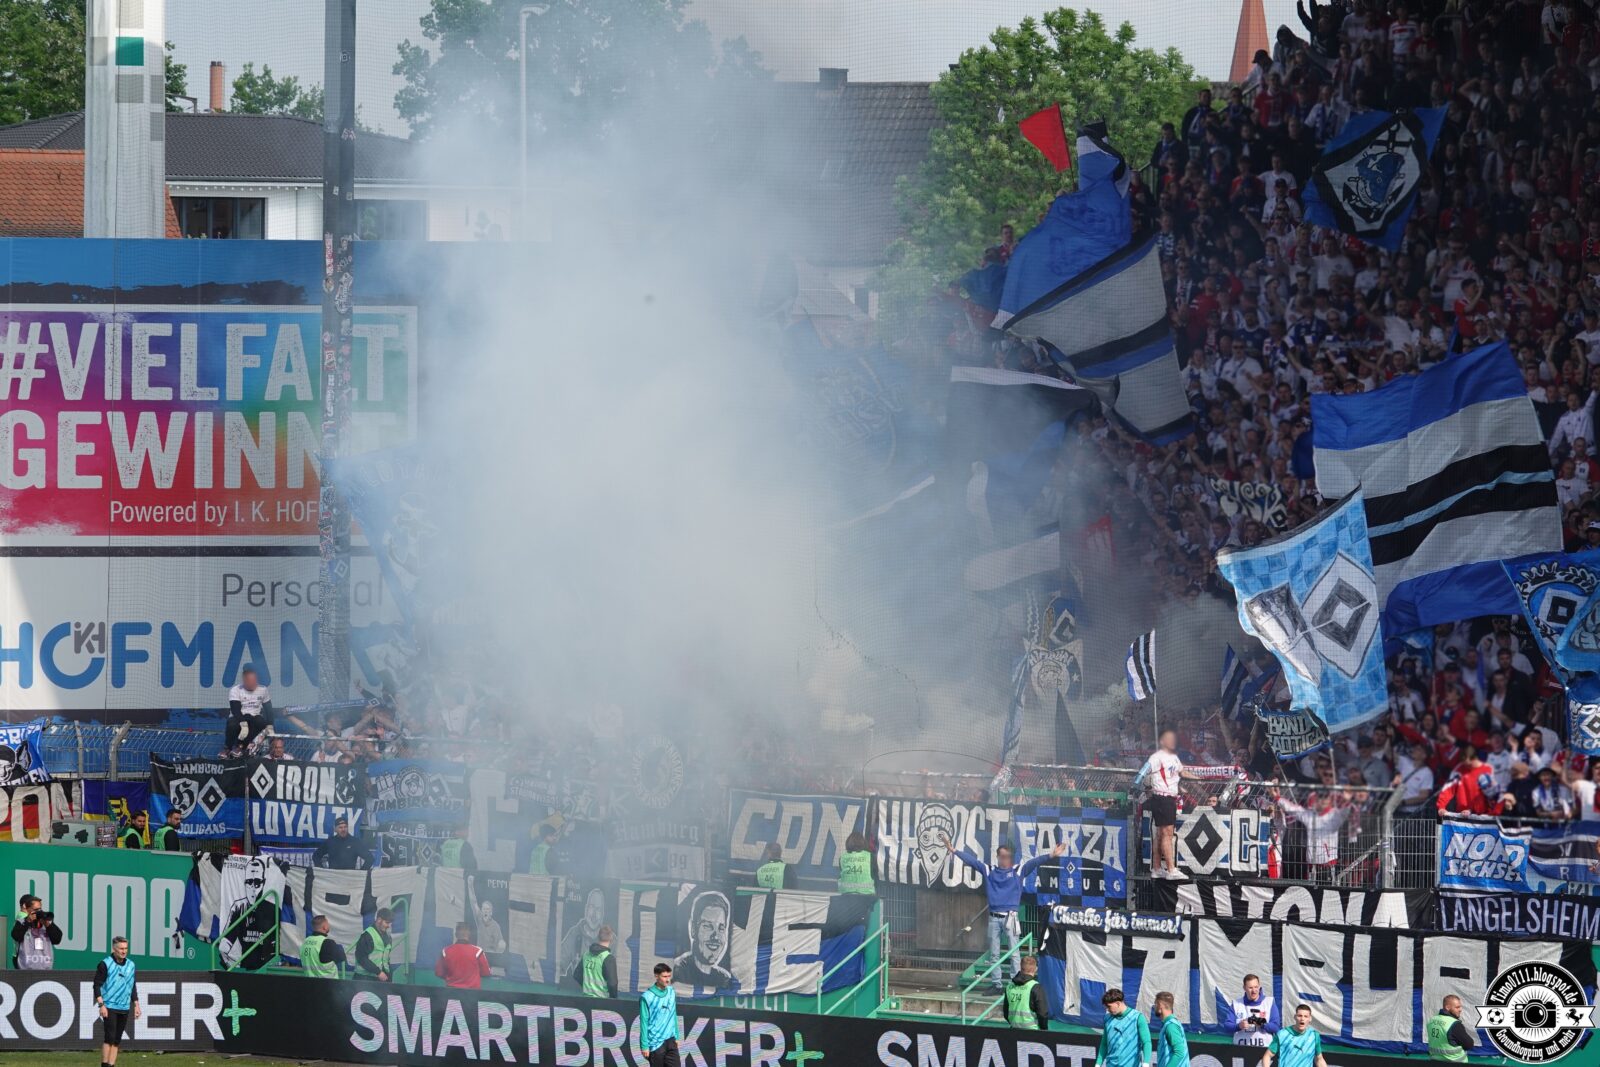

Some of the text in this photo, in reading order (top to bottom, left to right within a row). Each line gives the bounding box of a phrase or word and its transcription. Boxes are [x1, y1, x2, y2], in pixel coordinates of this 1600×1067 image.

[0, 321, 399, 401] #VIELFAT
[110, 501, 197, 523] Powered
[204, 501, 227, 526] by
[234, 502, 245, 522] I.
[251, 502, 270, 522] K.
[221, 573, 383, 607] Persoal
[173, 763, 225, 775] HAMBURG
[276, 764, 336, 805] IRON
[252, 801, 363, 840] LOYALTY
[1015, 821, 1125, 874] FORZA
[764, 874, 776, 884] 46
[845, 865, 864, 875] 244
[15, 868, 186, 960] PUMA
[1131, 911, 1182, 935] immer!
[1439, 896, 1600, 943] LANGELSHEIM
[1061, 915, 1564, 1050] HAMBUR
[1430, 1027, 1441, 1039] 82
